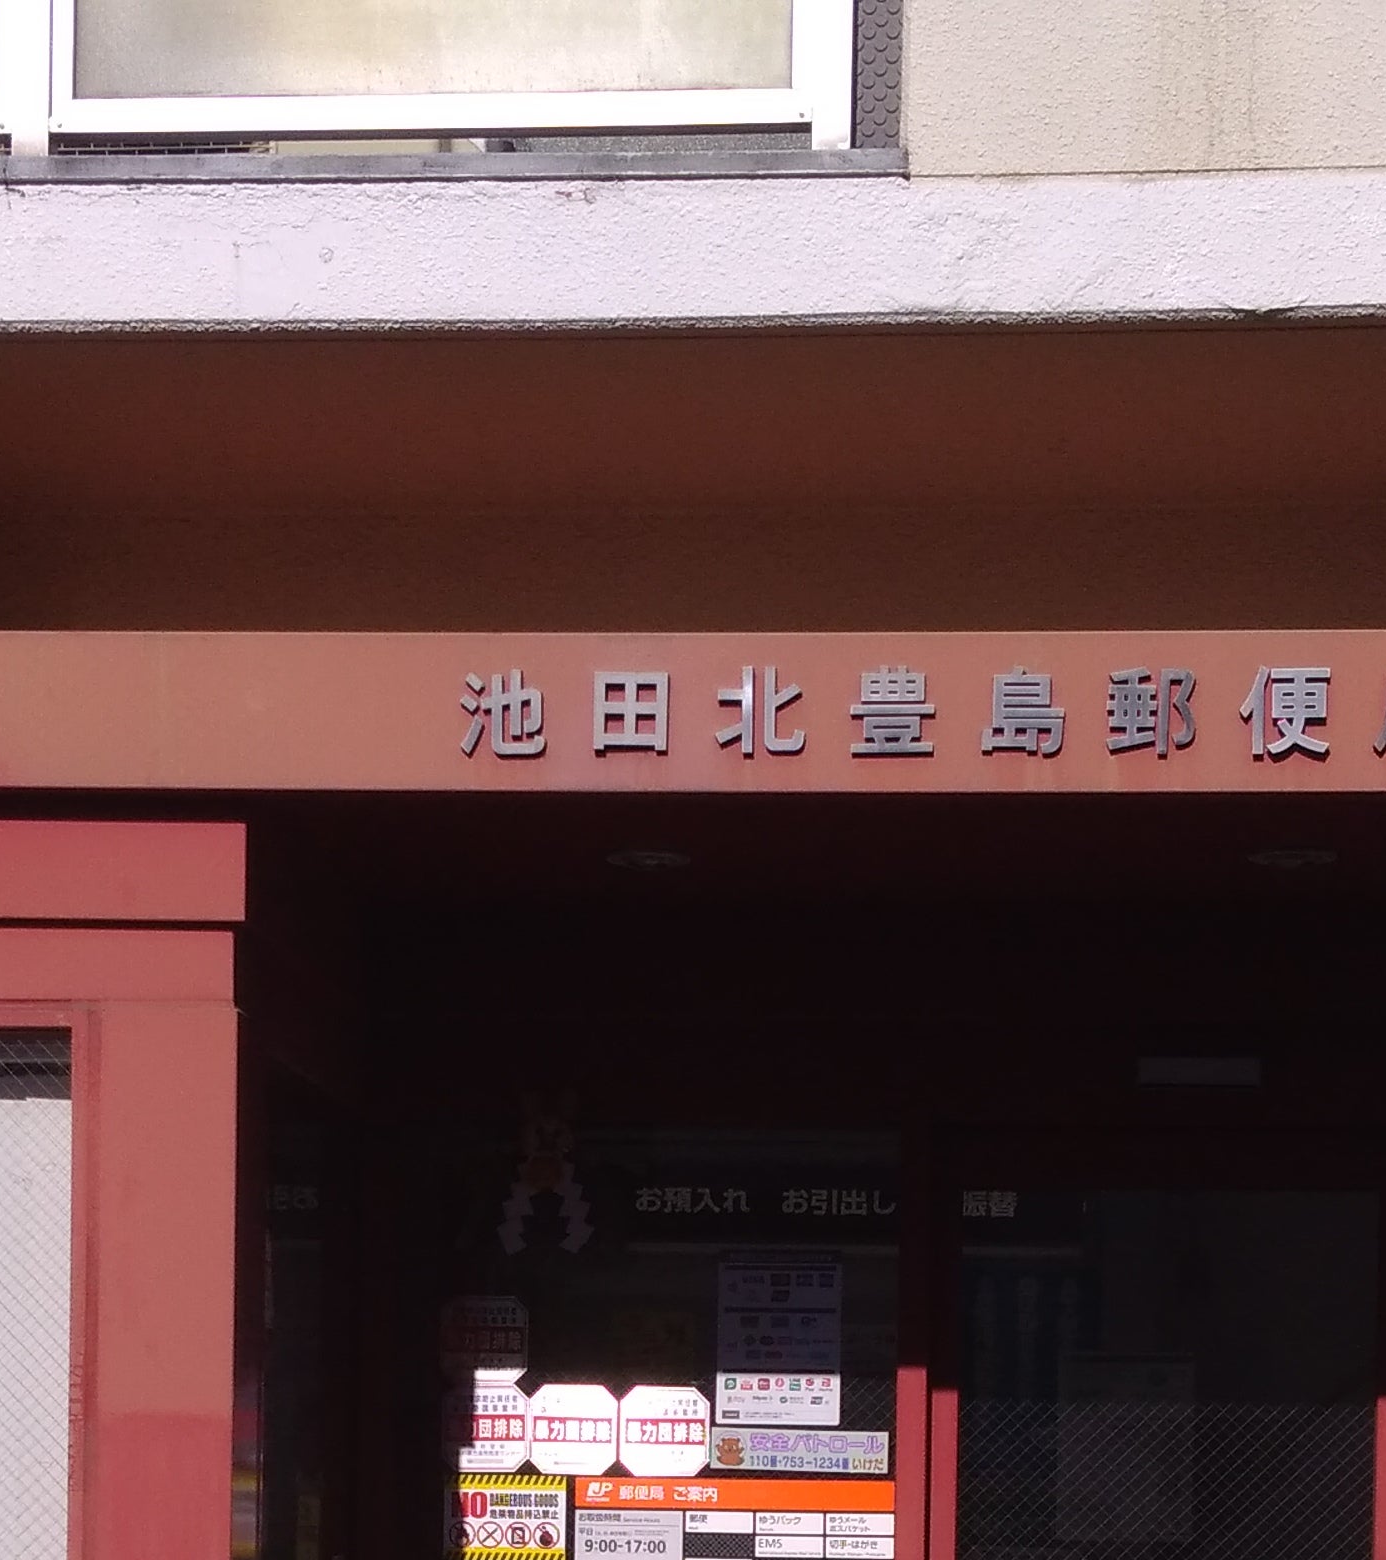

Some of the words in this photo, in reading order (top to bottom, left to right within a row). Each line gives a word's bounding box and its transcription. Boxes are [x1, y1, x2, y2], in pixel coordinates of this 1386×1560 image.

[635, 1187, 749, 1214] お預入れ
[781, 1187, 896, 1216] お引出し
[749, 1433, 885, 1455] 安全パトロール
[618, 1485, 664, 1501] 郵便局
[673, 1486, 717, 1502] ご案内
[758, 1515, 801, 1525] ゆうパック
[584, 1539, 666, 1553] 9:00-17:00
[758, 1539, 782, 1549] EMS
